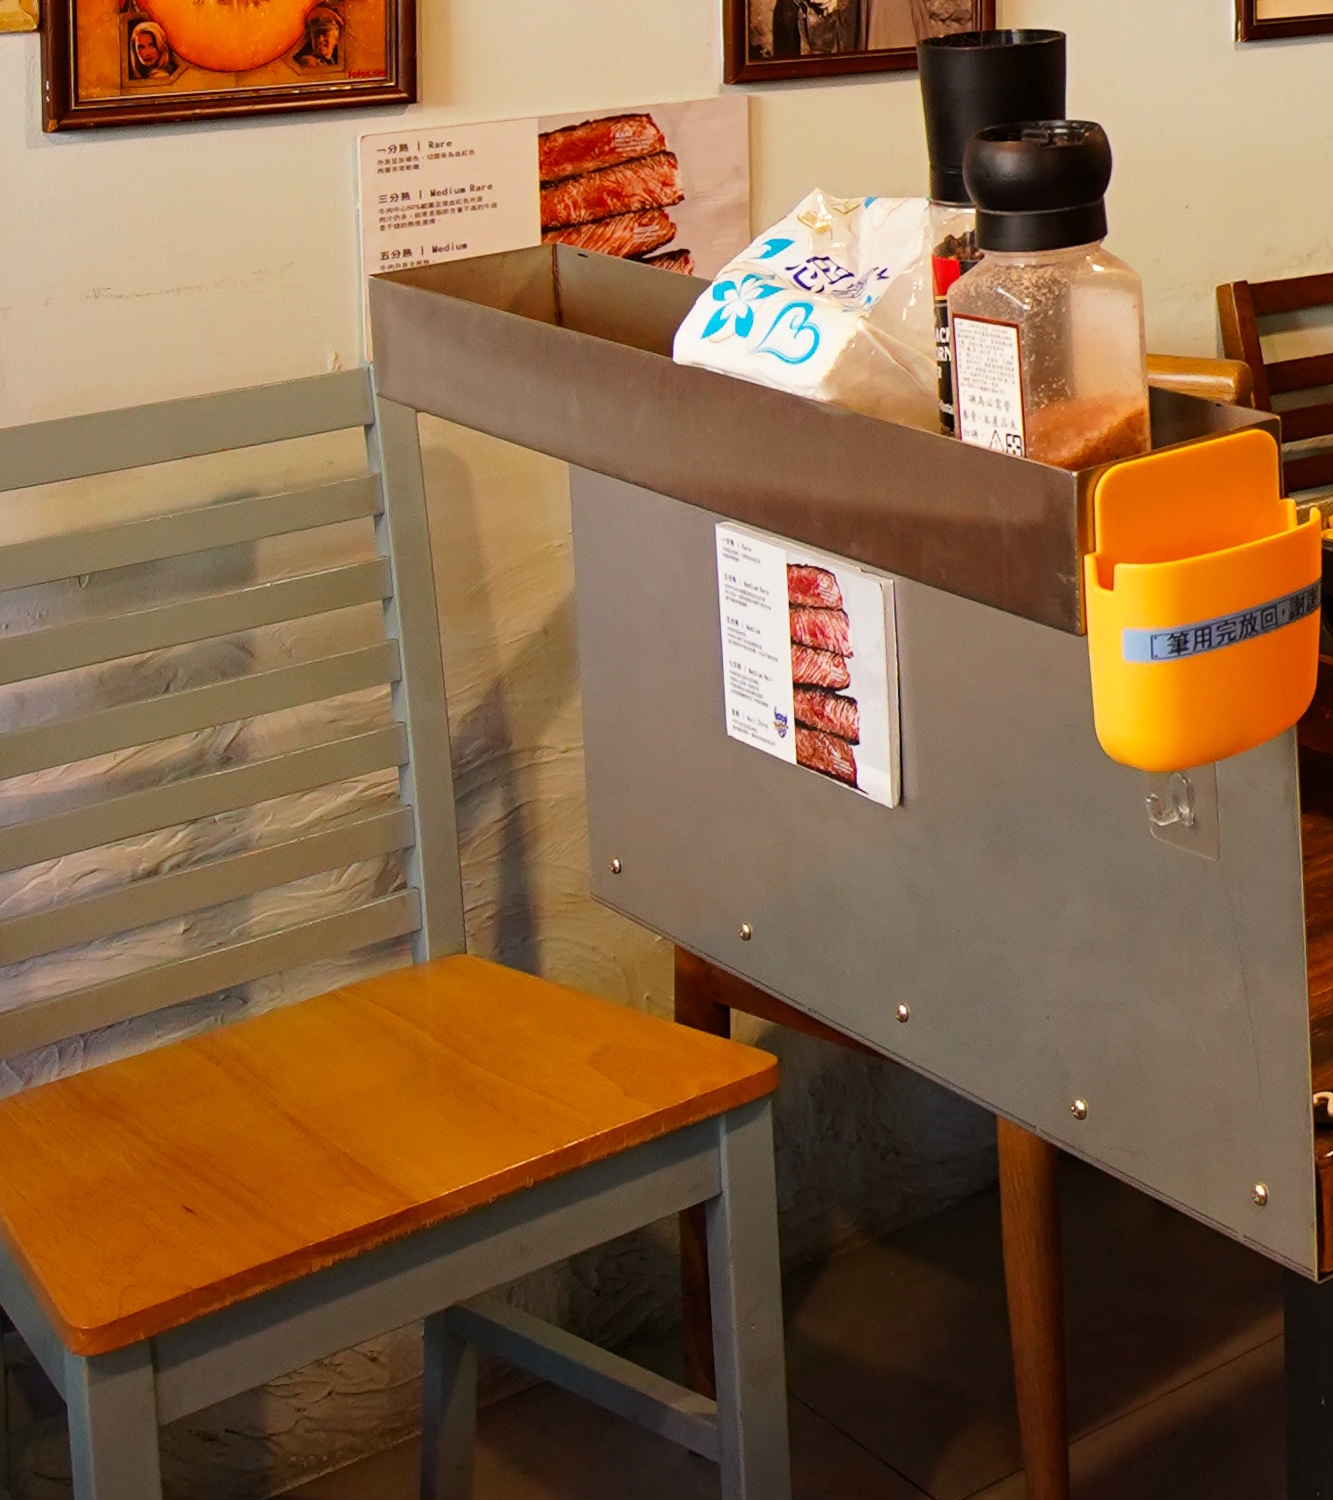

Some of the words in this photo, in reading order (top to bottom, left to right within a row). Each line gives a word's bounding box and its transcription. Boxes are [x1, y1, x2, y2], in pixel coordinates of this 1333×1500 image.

[377, 143, 409, 154] 一分熟
[428, 141, 453, 149] Rare
[430, 187, 466, 197] Medium
[469, 184, 494, 192] Rare
[378, 191, 411, 204] 三分熟
[379, 248, 413, 261] 五分熟
[432, 243, 468, 254] Medium
